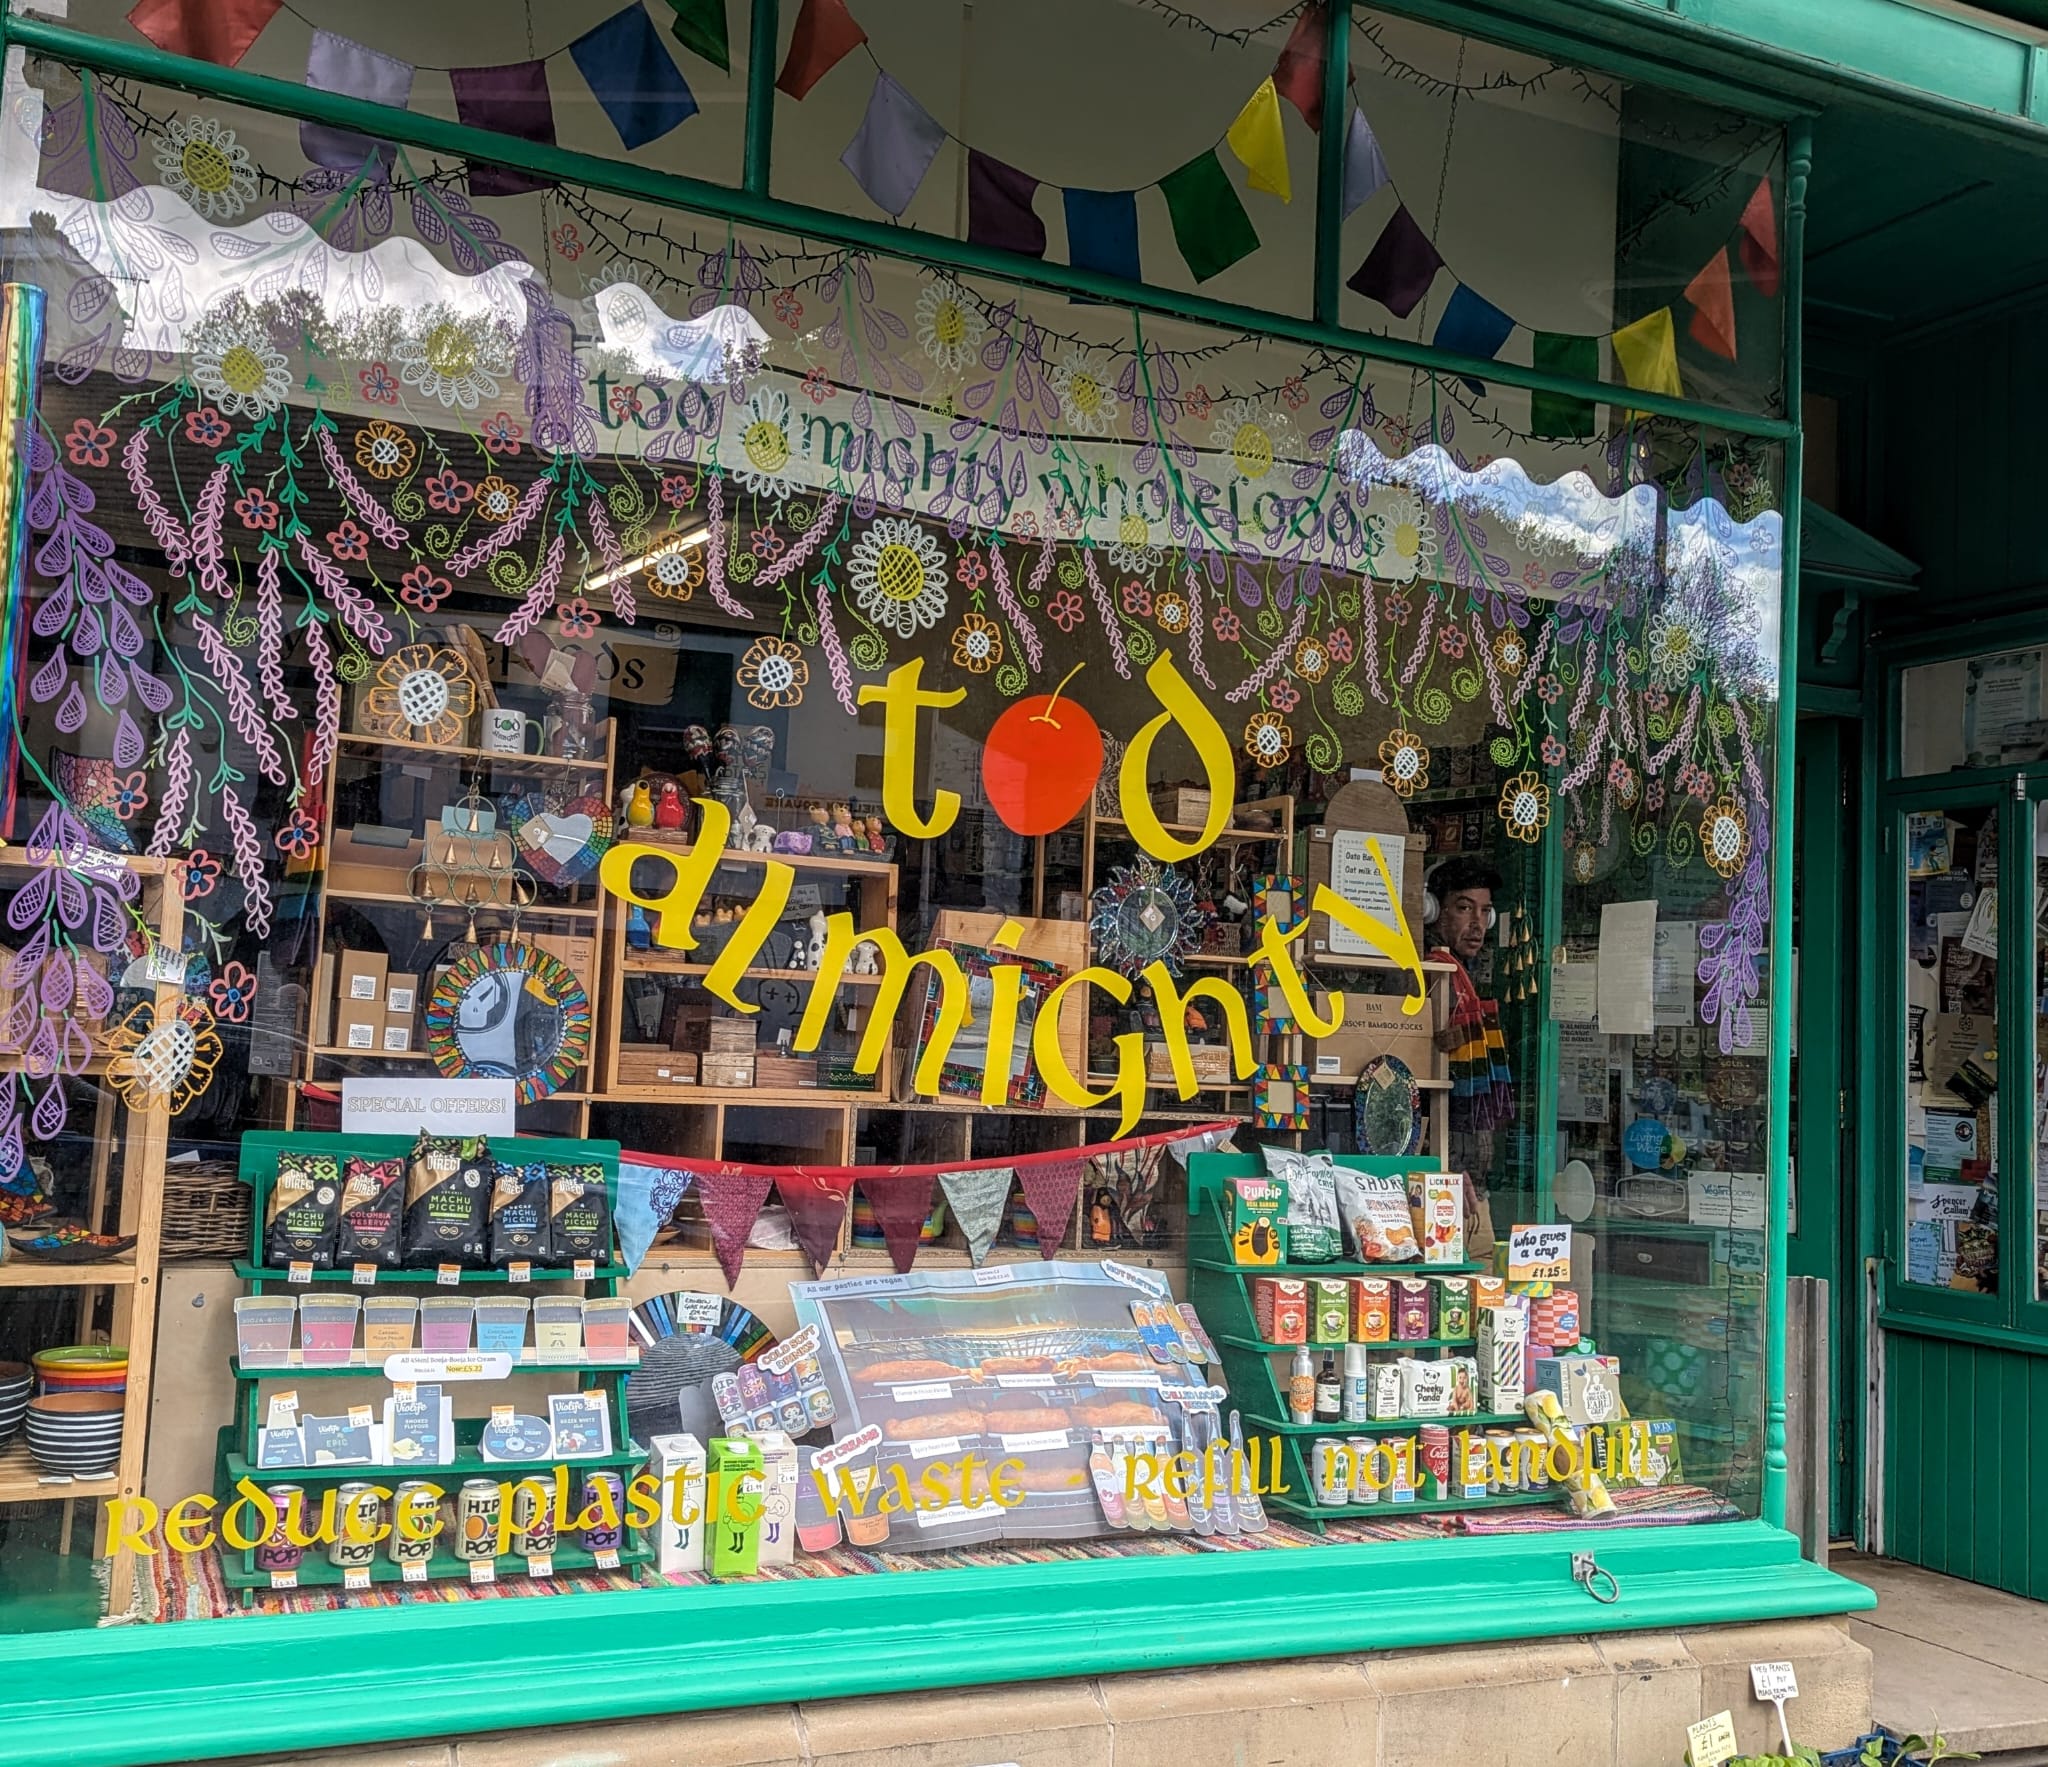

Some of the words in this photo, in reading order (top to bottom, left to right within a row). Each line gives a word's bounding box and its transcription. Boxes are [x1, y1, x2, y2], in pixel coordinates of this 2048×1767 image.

[1366, 1003, 1382, 1012] BAM
[1368, 1020, 1398, 1030] BAMBOO
[347, 1095, 426, 1114] SPECIAL
[431, 1096, 506, 1115] OFFERS!
[1630, 1132, 1663, 1145] Living
[1636, 1142, 1667, 1155] Wage
[427, 1155, 462, 1171] DIRECT
[284, 1178, 315, 1192] DIRECT
[353, 1180, 381, 1197] DIRECT
[1243, 1184, 1282, 1200] PUKPIP
[431, 1195, 471, 1205] MACHU
[428, 1203, 472, 1213] PICCHU
[287, 1211, 325, 1219] MACHU
[350, 1211, 391, 1219] COLOMBIA
[286, 1219, 325, 1227] PICCHU
[350, 1219, 390, 1227] RESERVA
[1513, 1232, 1537, 1248] who
[1539, 1231, 1567, 1247] gives
[1520, 1250, 1530, 1258] a
[1534, 1245, 1559, 1260] crap
[1532, 1265, 1560, 1278] £1.25
[834, 1280, 863, 1292] pasties
[880, 1276, 903, 1286] vegan
[762, 1344, 791, 1365] COLD
[790, 1325, 817, 1348] SOFT
[775, 1340, 815, 1370] DRINKS
[713, 1378, 735, 1393] HIP
[800, 1372, 822, 1386] POP
[1415, 1383, 1444, 1395] Cheeky
[1417, 1393, 1441, 1402] Panda
[395, 1402, 428, 1415] Violife
[555, 1401, 583, 1414] Violife
[720, 1402, 742, 1416] POP
[1587, 1400, 1609, 1410] EARL
[318, 1425, 341, 1434] Violife
[494, 1426, 519, 1437] Violife
[1653, 1421, 1673, 1431] WIN
[269, 1429, 294, 1439] Violife
[326, 1439, 348, 1448] EPIC
[816, 1449, 835, 1467] ICE
[835, 1427, 880, 1463] CREAMS
[496, 1464, 768, 1555] plastic
[1323, 1435, 1427, 1491] not
[1458, 1425, 1656, 1491] landfill
[467, 1498, 500, 1513] HIP
[525, 1537, 556, 1550] POP
[585, 1531, 618, 1546] POP
[340, 1543, 375, 1560] POP
[397, 1542, 432, 1557] POP
[465, 1540, 498, 1554] POP
[263, 1548, 299, 1563] POP
[1754, 1665, 1767, 1673] VEG
[1768, 1664, 1791, 1672] PLANTS
[1692, 1717, 1717, 1734] PLANTS
[1702, 1733, 1713, 1750] £1
